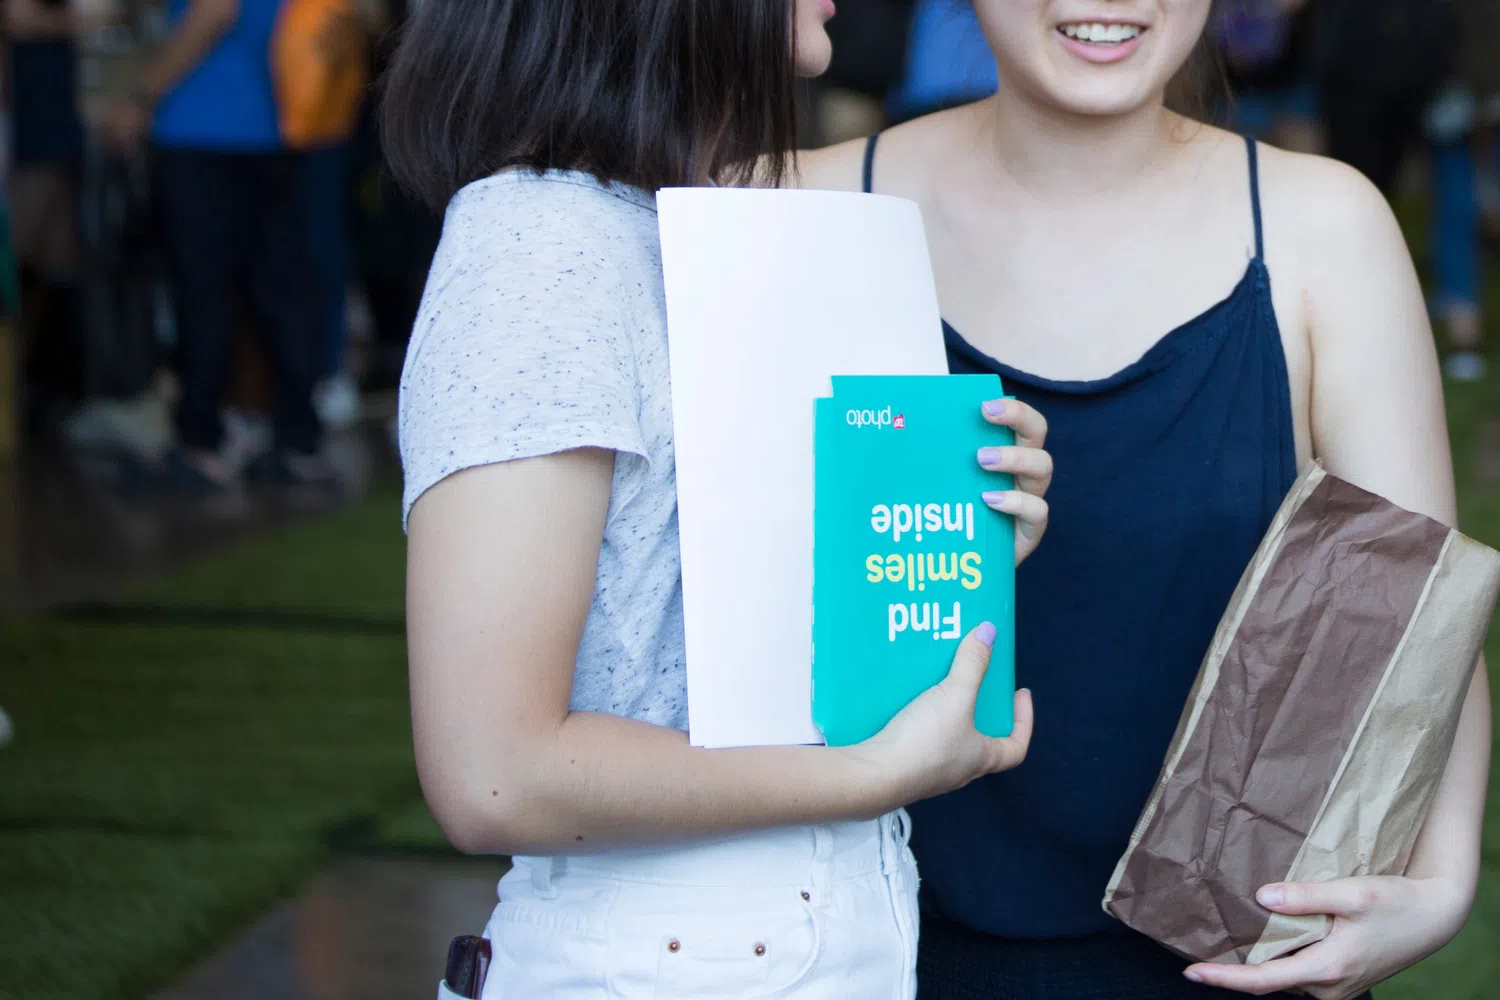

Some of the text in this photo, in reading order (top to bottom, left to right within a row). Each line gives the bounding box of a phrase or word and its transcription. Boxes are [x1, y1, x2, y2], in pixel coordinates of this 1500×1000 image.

[846, 405, 891, 429] photo
[871, 502, 974, 542] Inside
[865, 551, 982, 591] Smiles
[888, 601, 961, 641] Find
